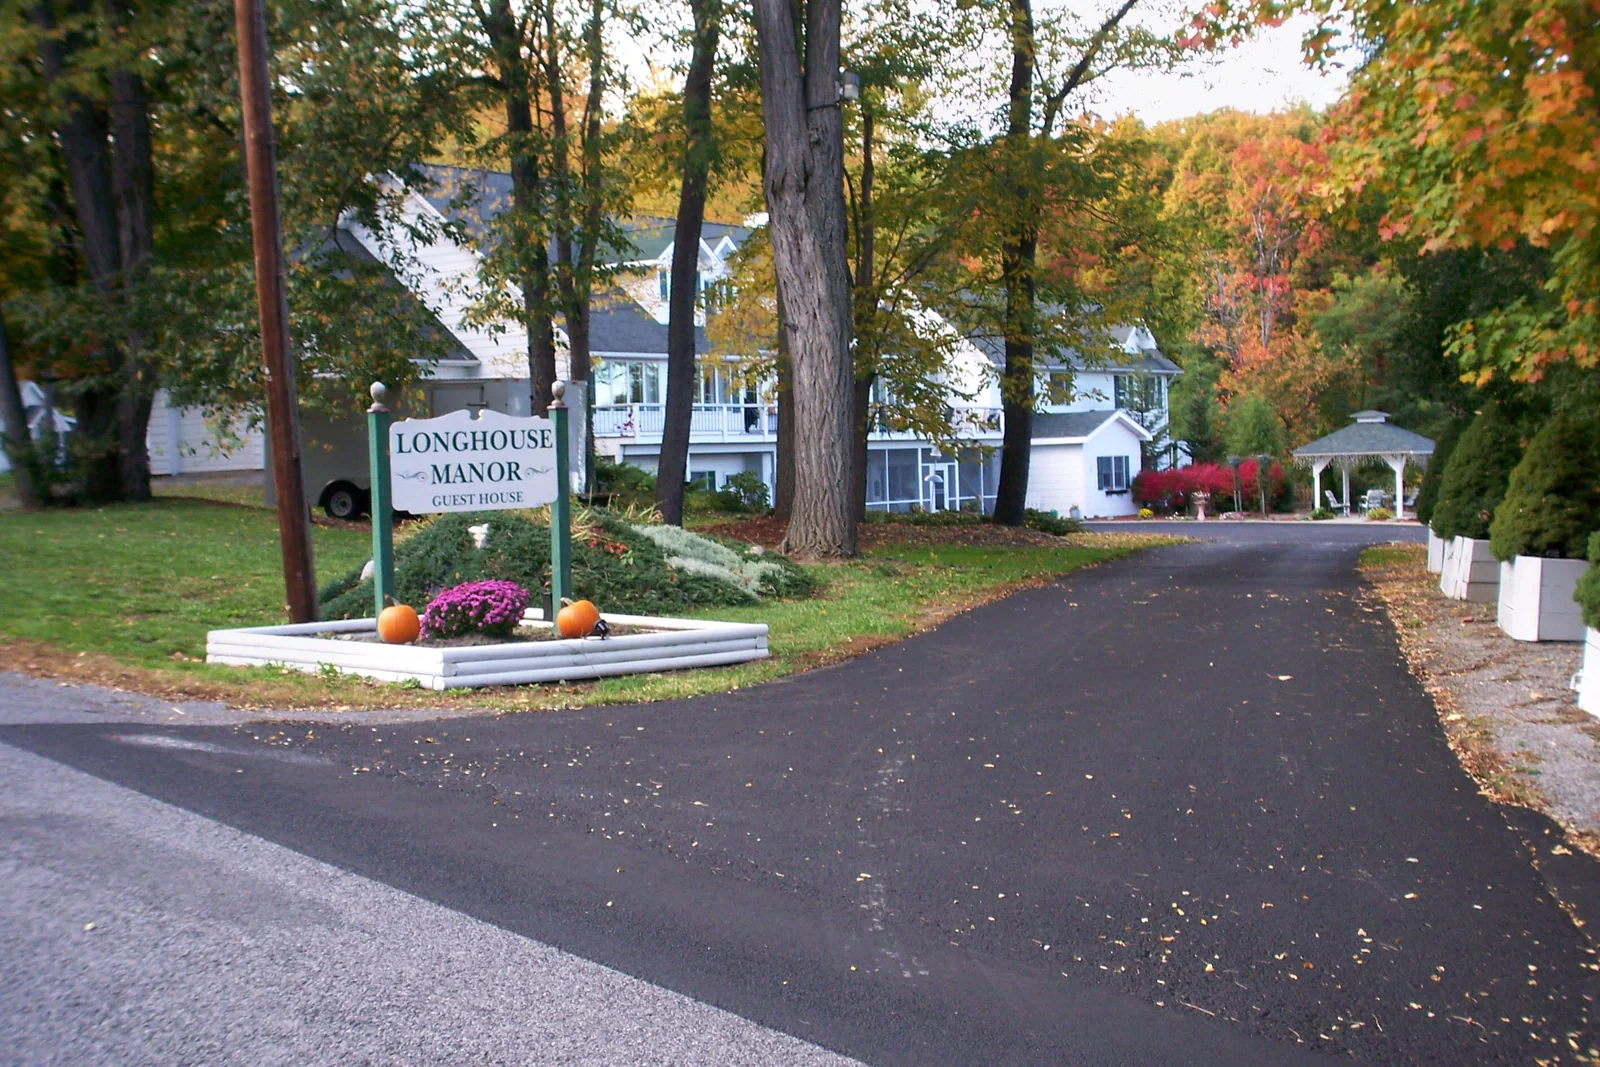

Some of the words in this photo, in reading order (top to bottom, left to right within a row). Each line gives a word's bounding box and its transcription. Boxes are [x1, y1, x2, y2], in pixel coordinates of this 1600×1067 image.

[396, 429, 553, 454] LONGHOUSE
[431, 461, 523, 485] MANOR
[432, 493, 475, 508] GUEST
[479, 491, 524, 505] HOUSE
